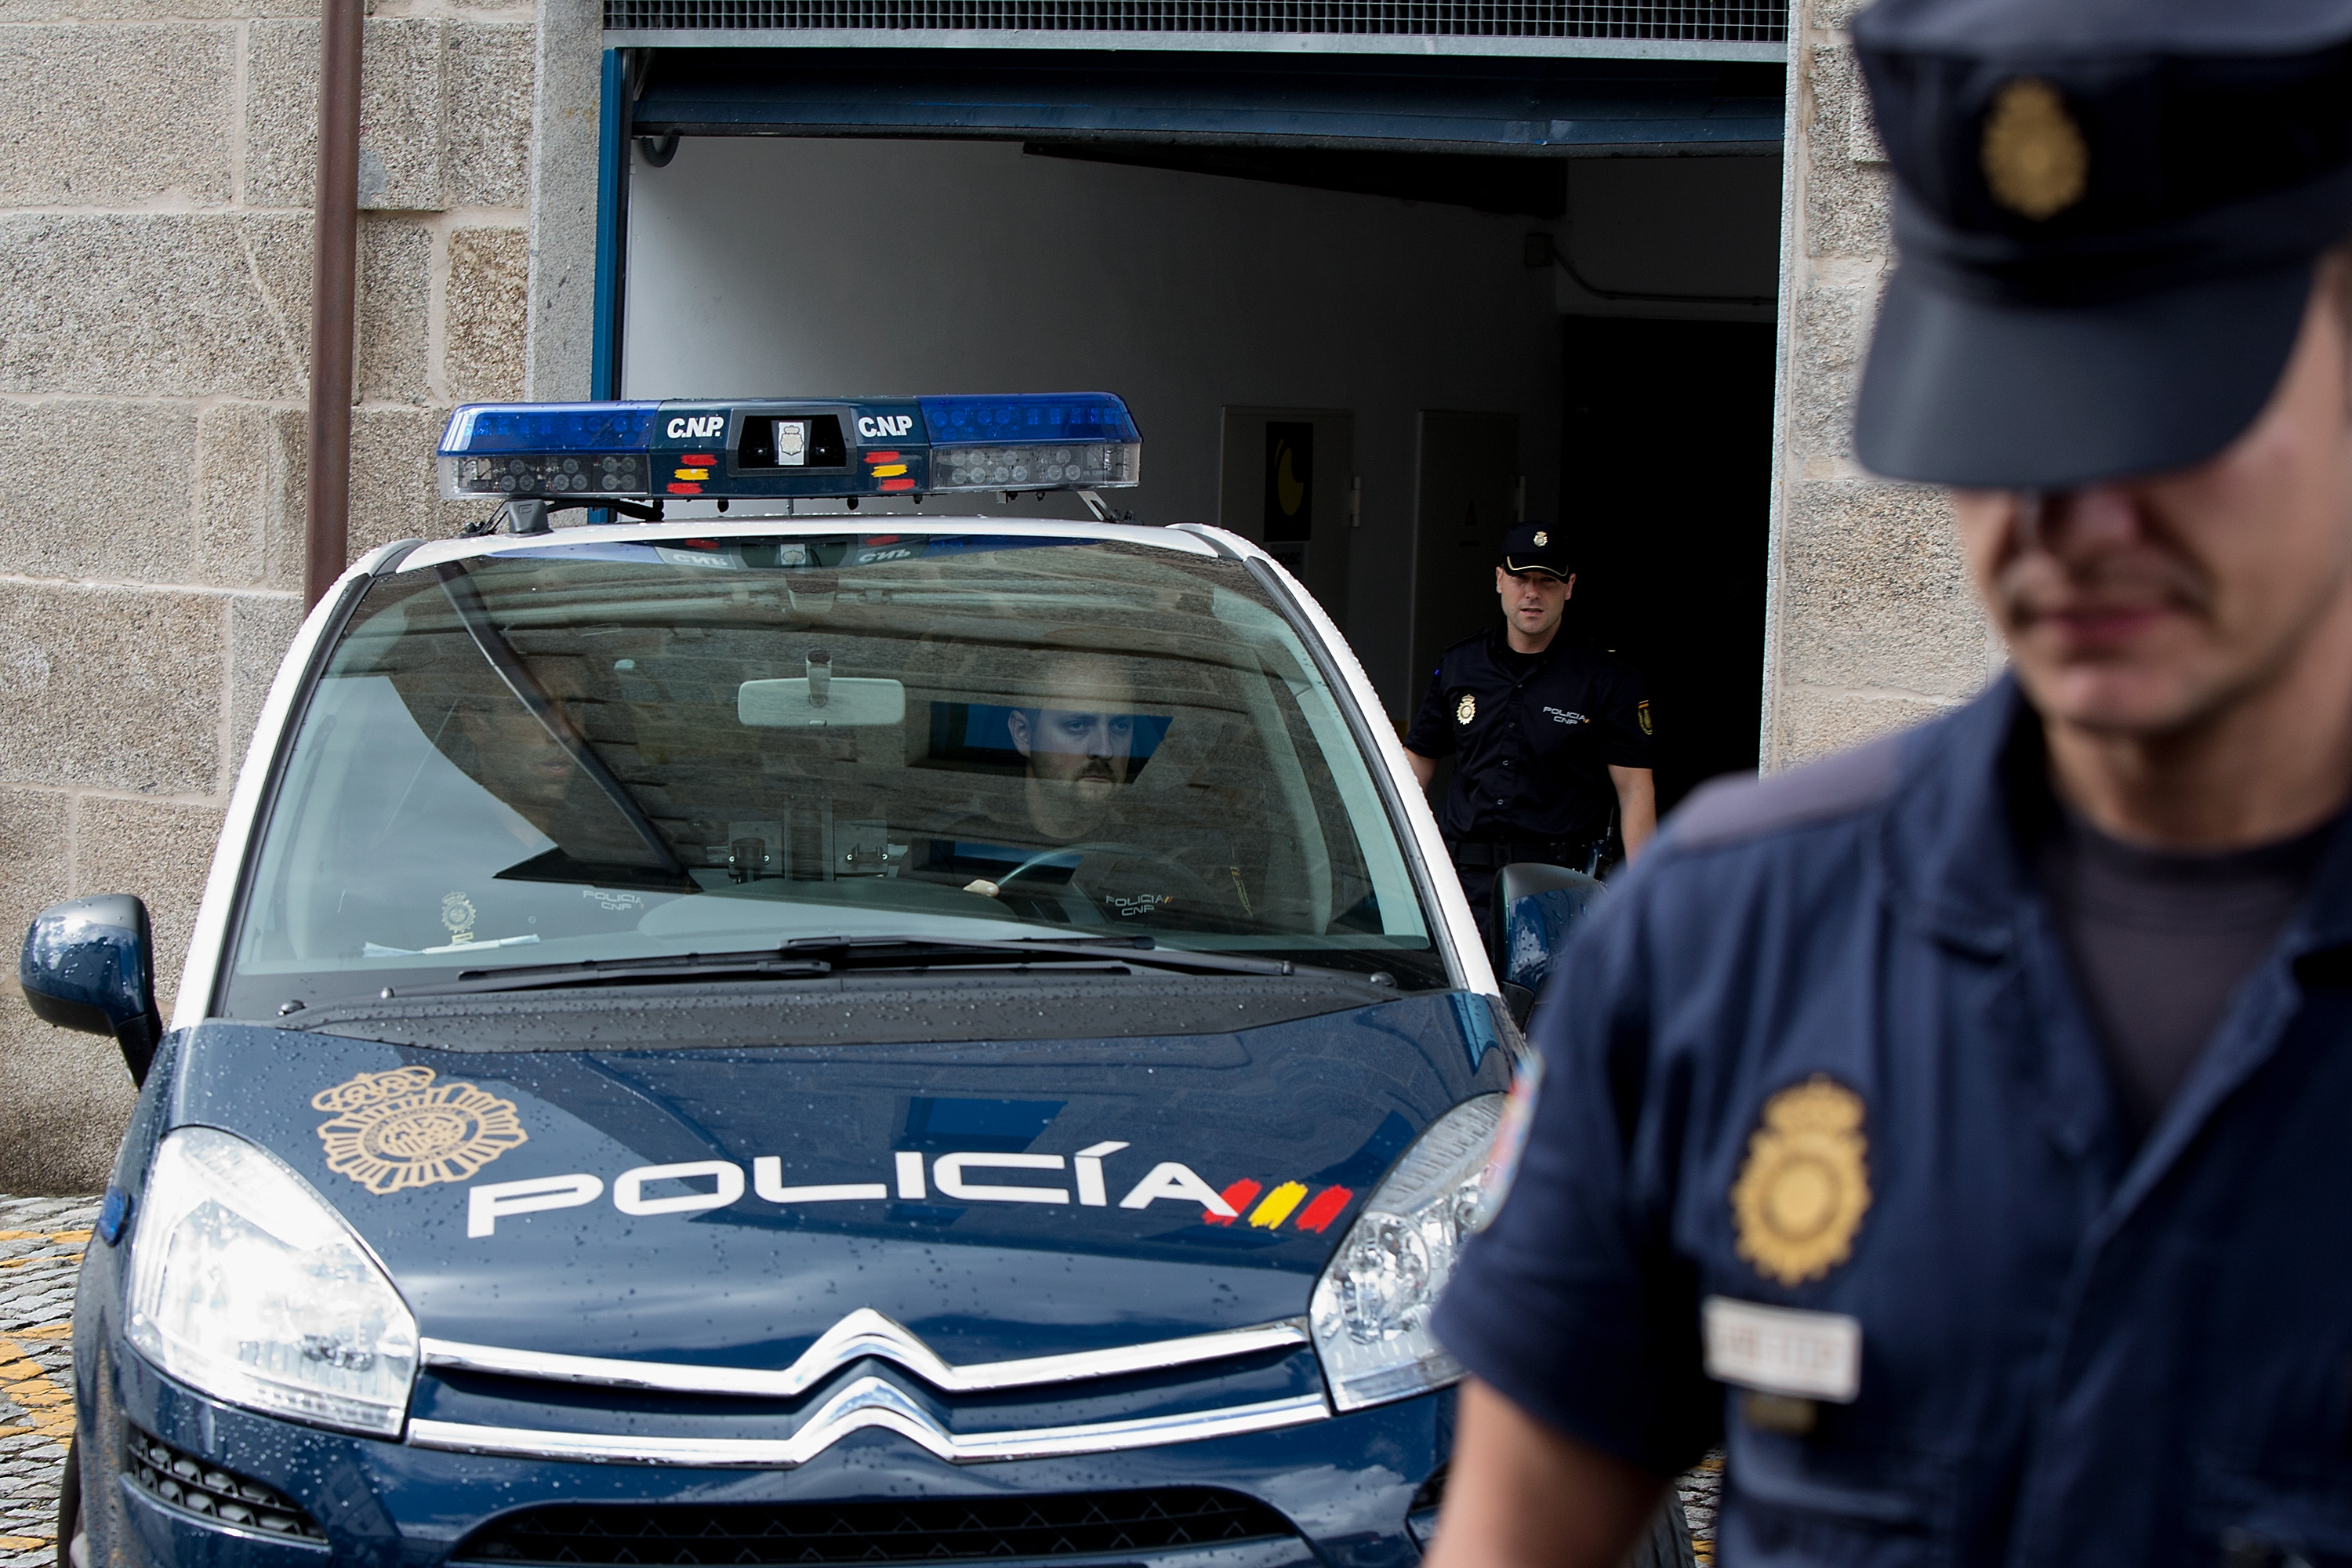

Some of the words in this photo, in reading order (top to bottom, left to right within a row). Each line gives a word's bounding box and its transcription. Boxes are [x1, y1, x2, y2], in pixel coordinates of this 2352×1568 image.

[667, 416, 724, 439] C.N.P.
[1543, 706, 1586, 722] POLICIA
[1553, 716, 1578, 725] CNP
[583, 890, 642, 904] POLICIA
[1105, 894, 1163, 906] POLICIA
[601, 902, 632, 911] CNP
[1122, 905, 1155, 916] CNP
[467, 1141, 1239, 1239] POLICÍA
